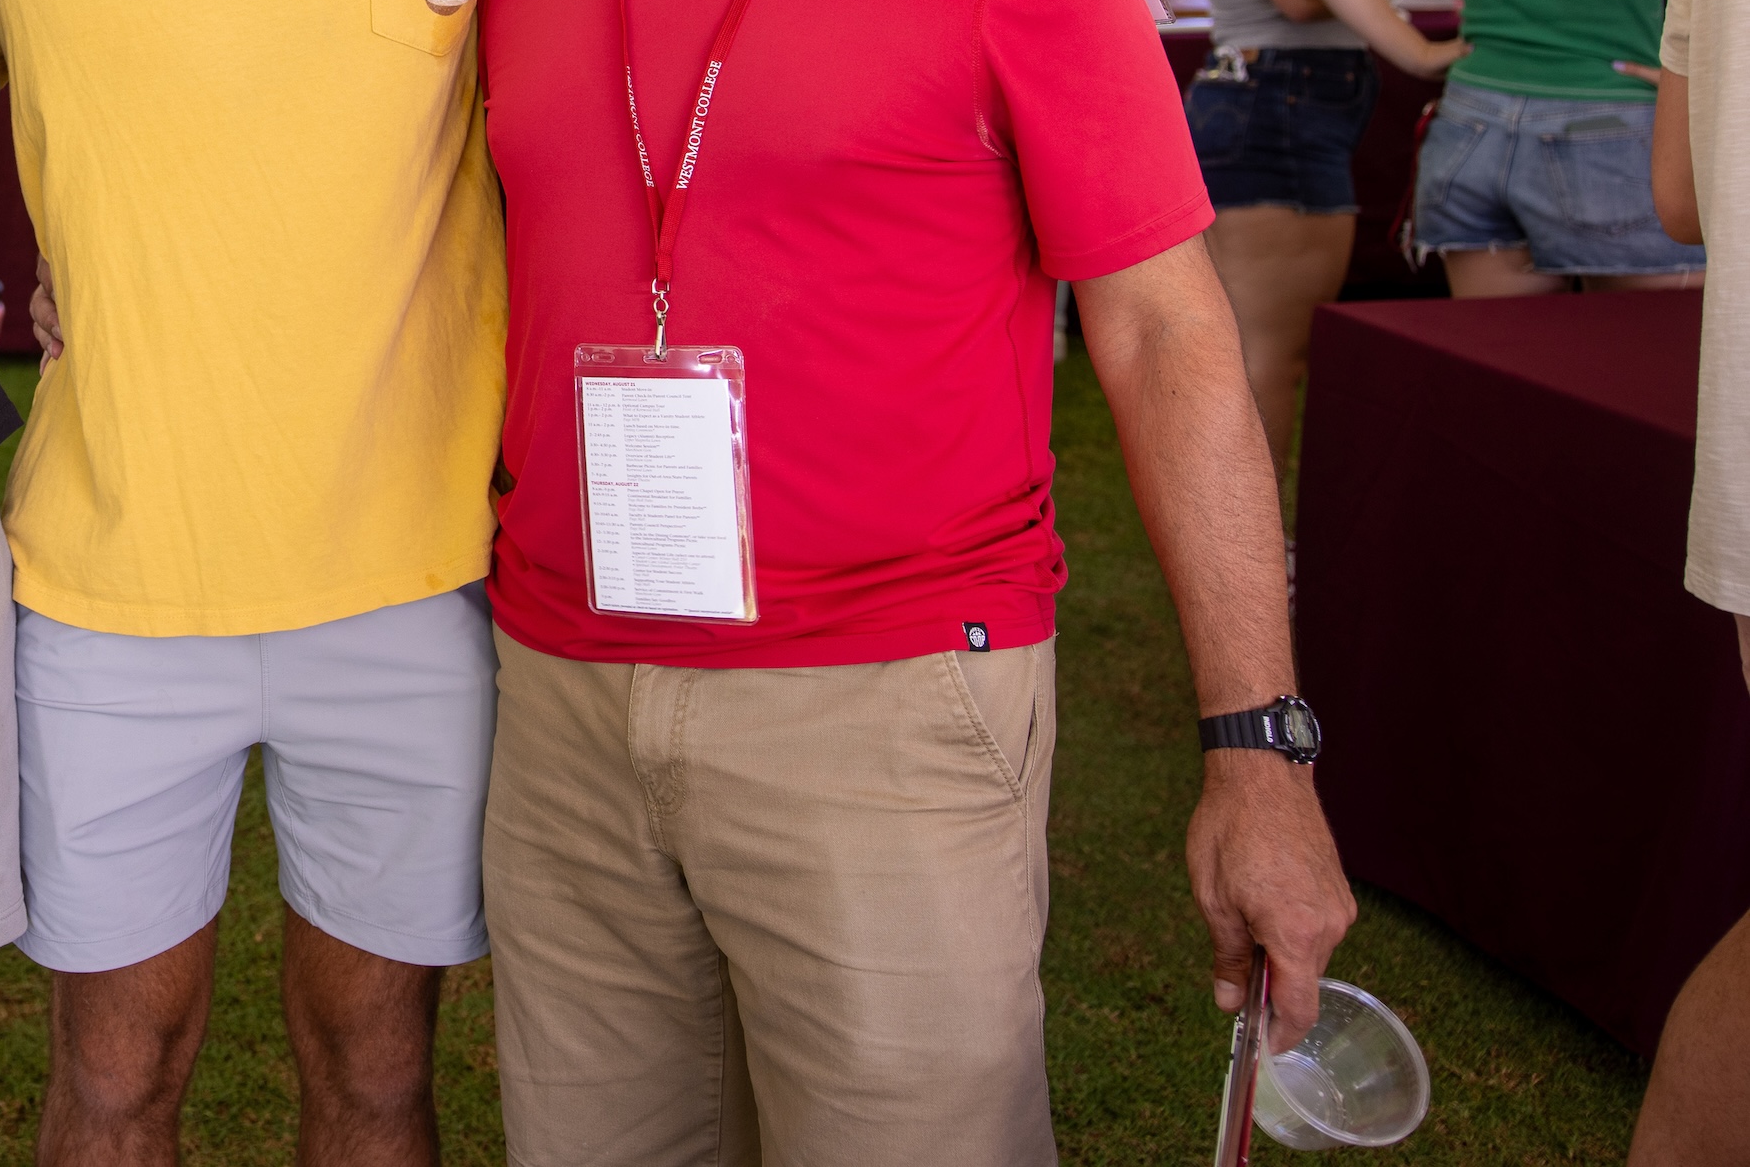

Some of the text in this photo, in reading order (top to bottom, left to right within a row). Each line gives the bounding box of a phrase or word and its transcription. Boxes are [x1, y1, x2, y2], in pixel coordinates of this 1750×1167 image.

[635, 133, 654, 188] COLLEGE
[676, 60, 722, 190] WESTMONT COLLEGE
